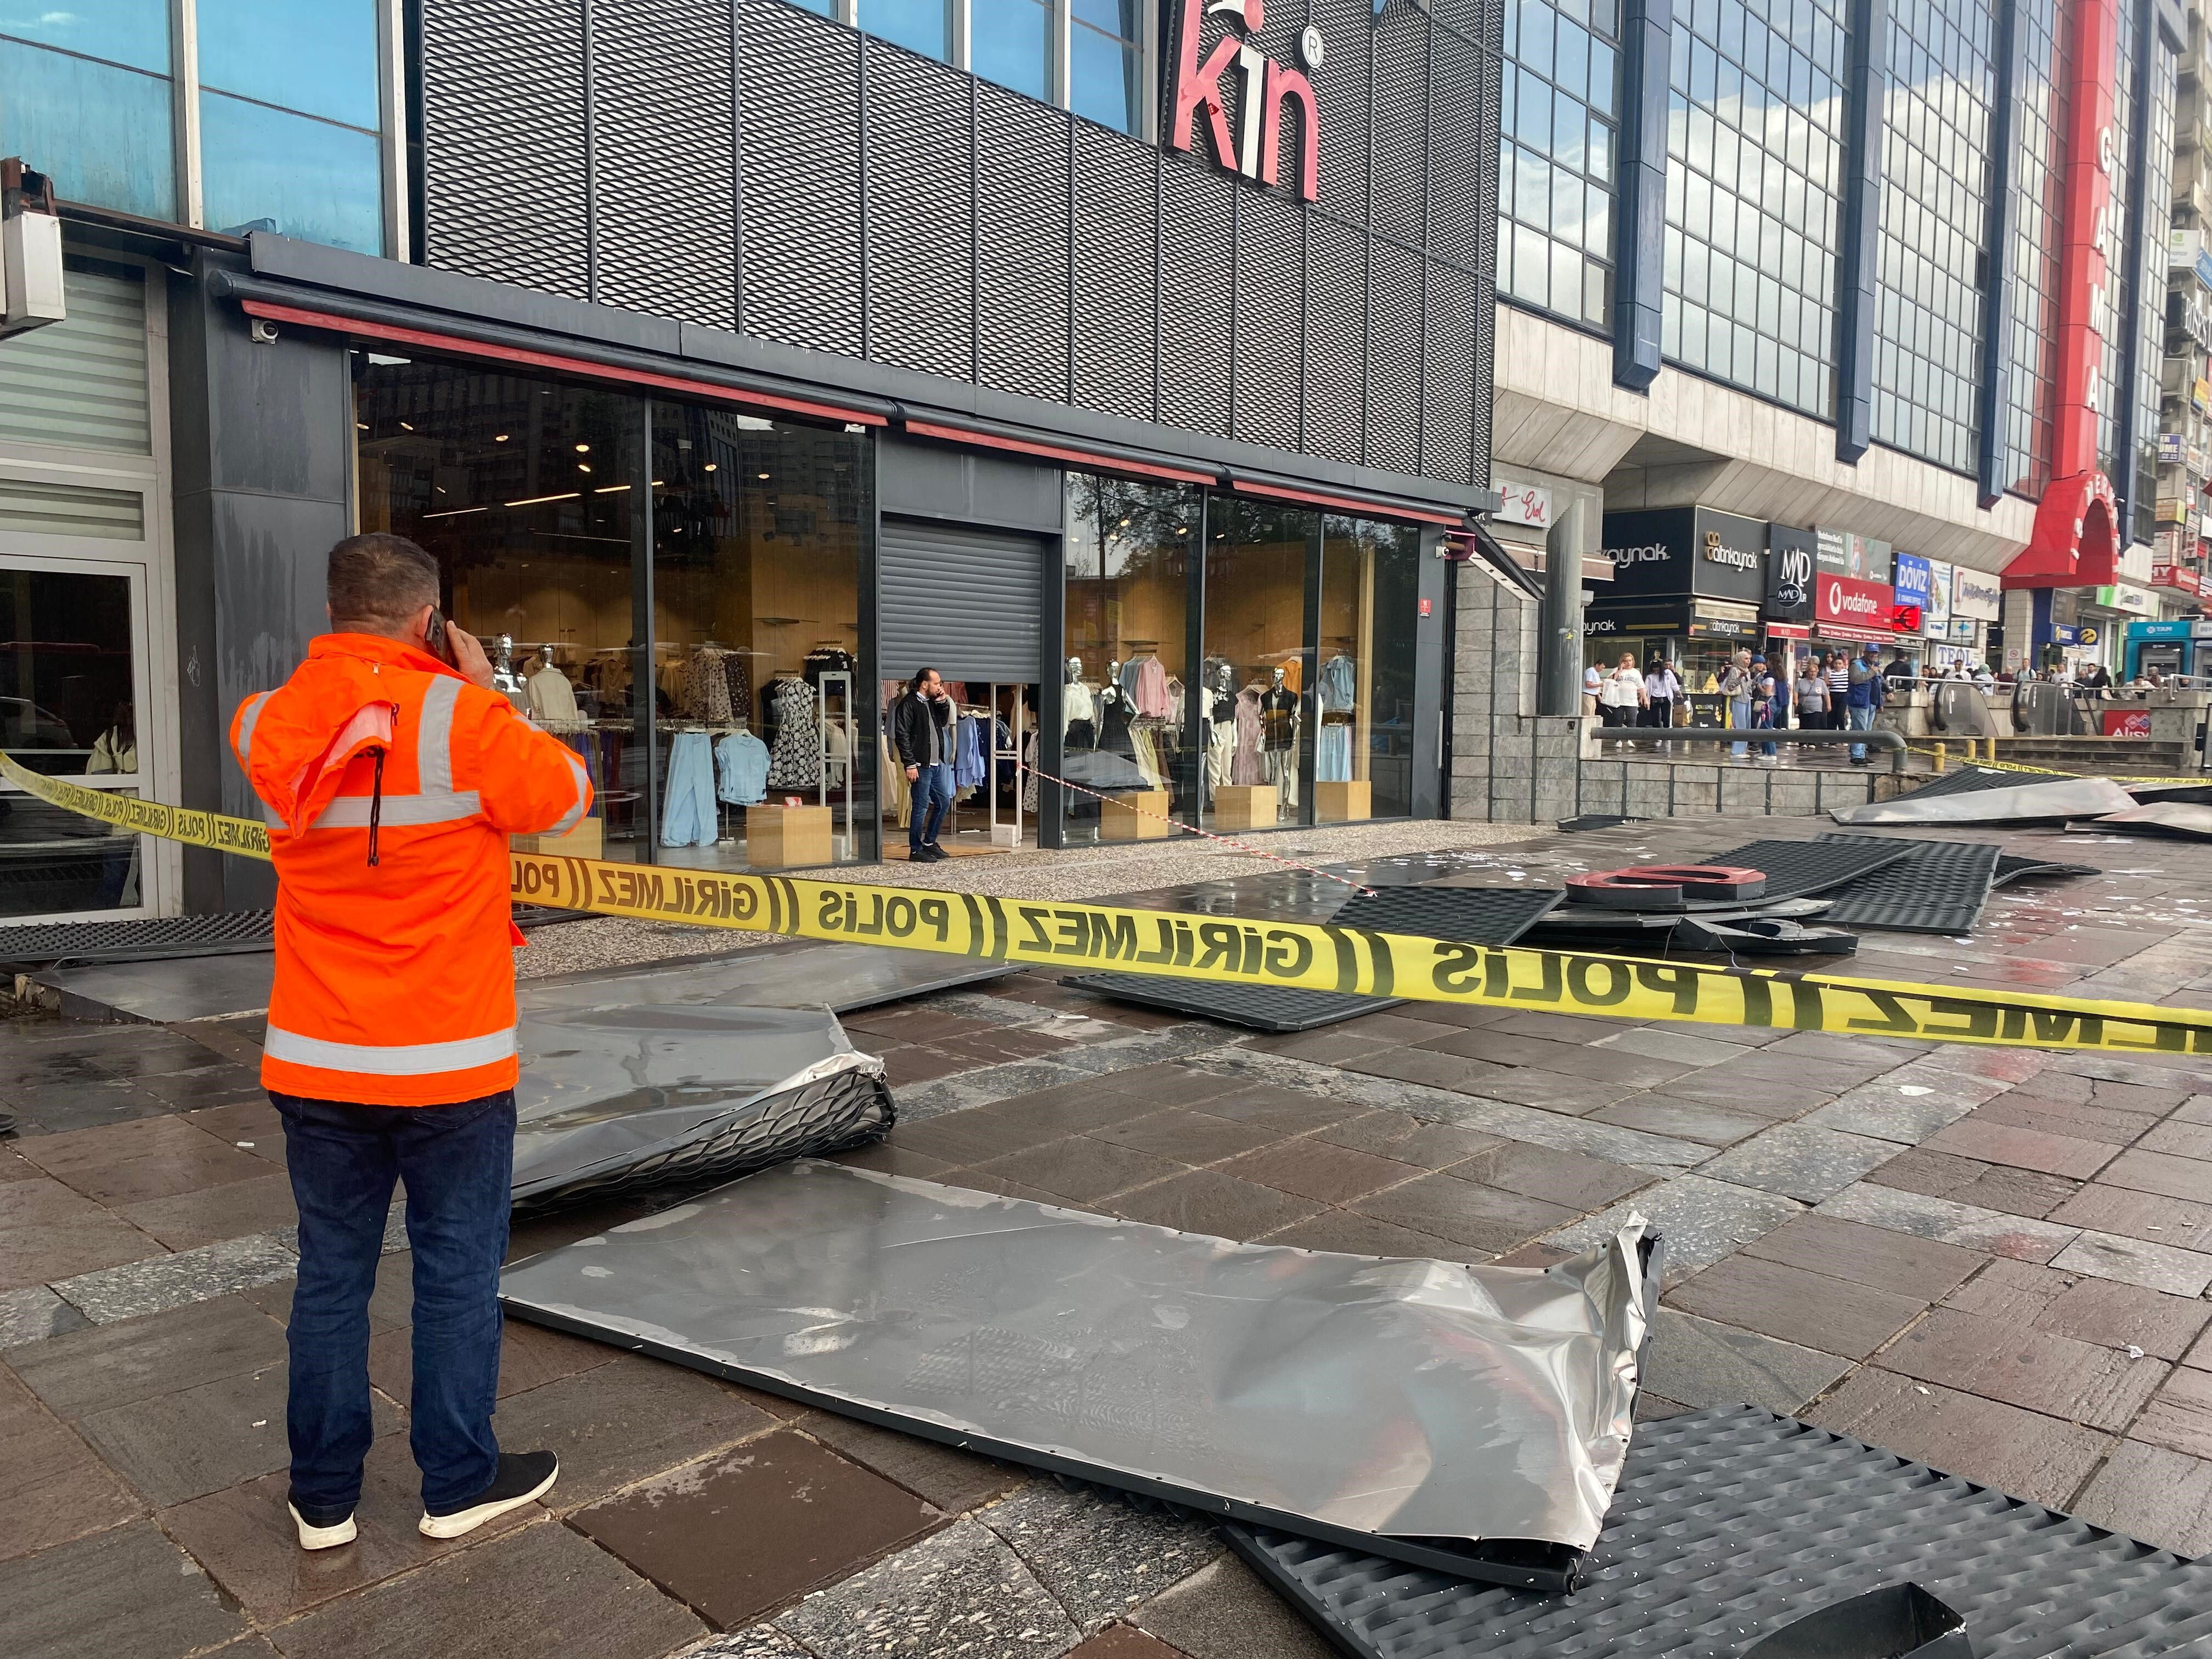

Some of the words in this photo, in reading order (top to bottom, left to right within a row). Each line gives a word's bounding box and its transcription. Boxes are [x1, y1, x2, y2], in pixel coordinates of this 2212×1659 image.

[1898, 560, 1927, 592] DÖVİZ
[1778, 589, 1799, 600] MAD
[1842, 592, 1877, 614] vodafone
